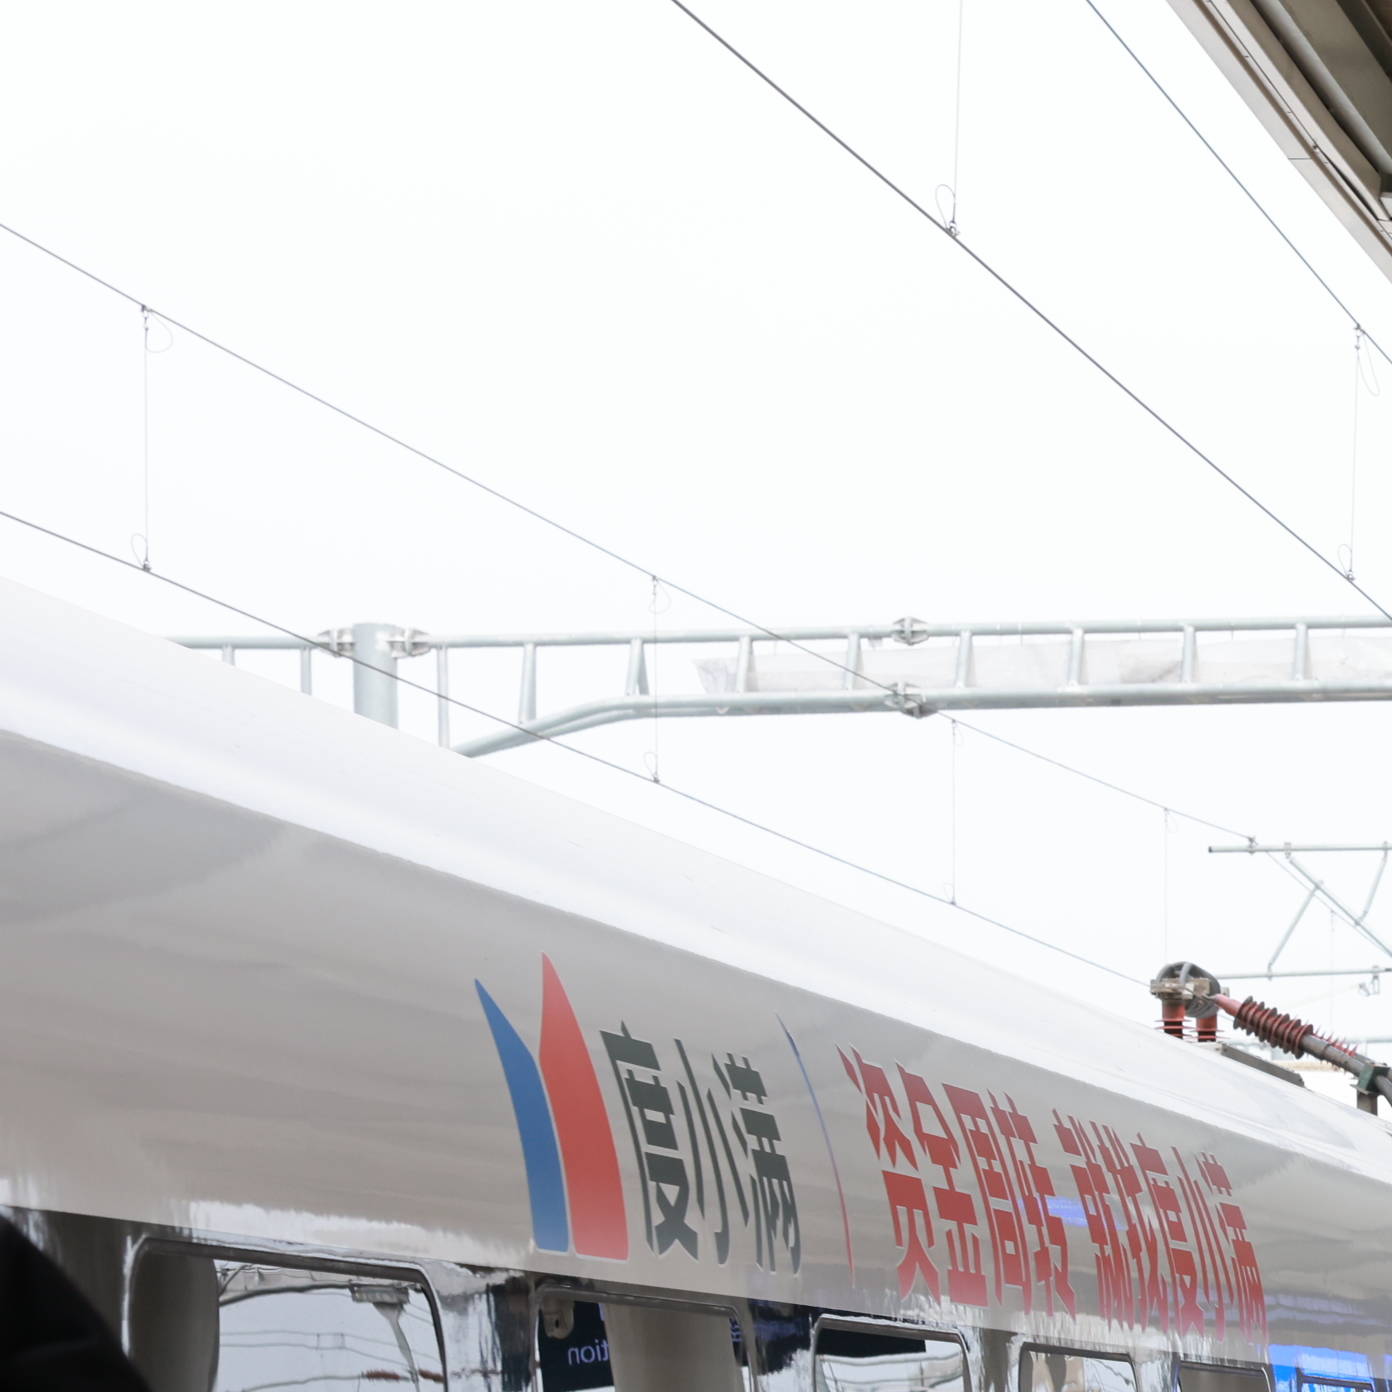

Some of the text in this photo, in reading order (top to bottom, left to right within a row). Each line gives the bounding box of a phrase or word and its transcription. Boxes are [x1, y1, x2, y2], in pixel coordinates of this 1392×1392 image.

[599, 1019, 800, 1275] 度小满
[835, 1043, 1269, 1346] 资金周转 就找度小满
